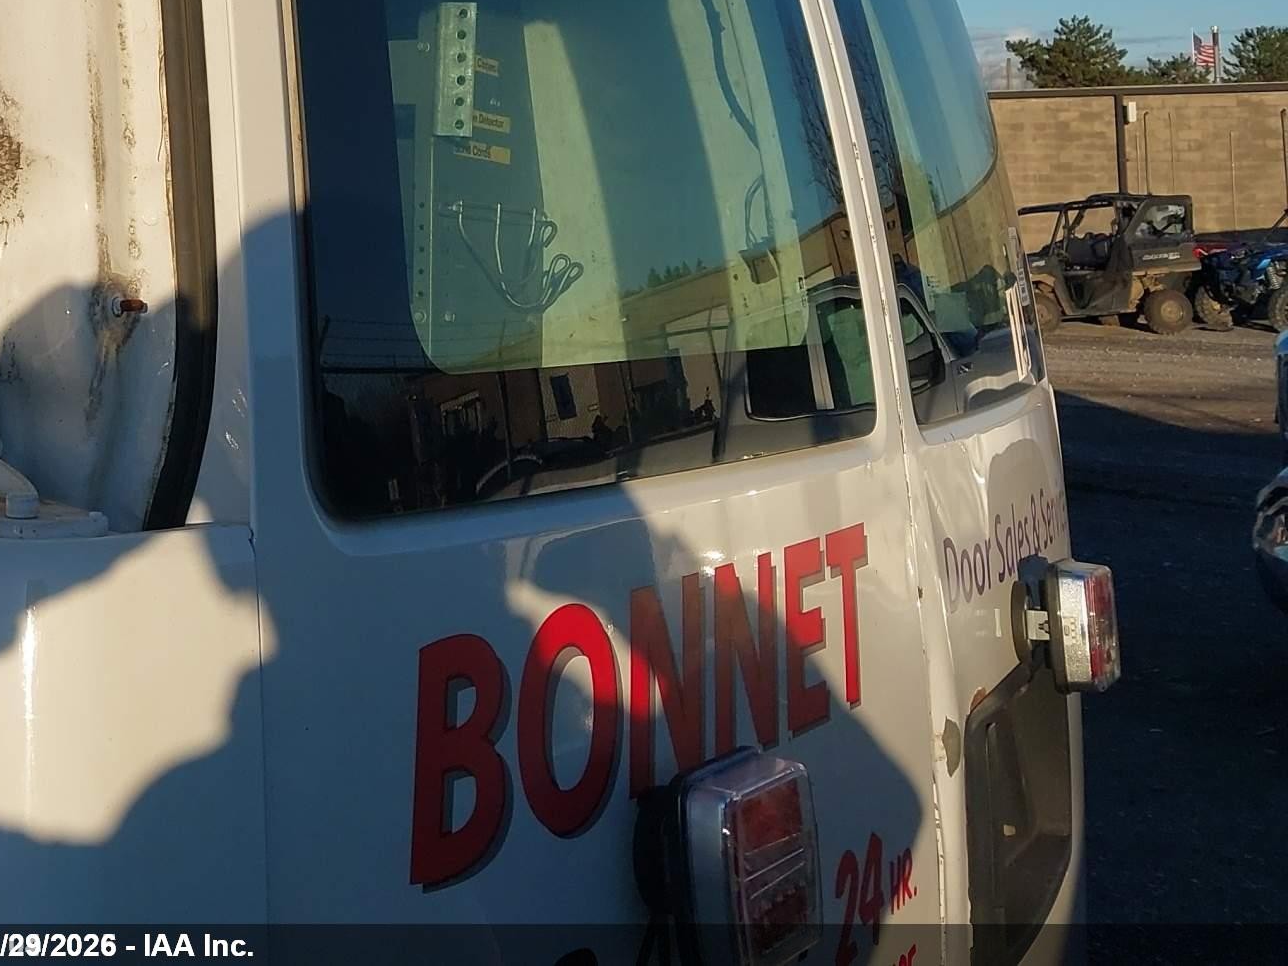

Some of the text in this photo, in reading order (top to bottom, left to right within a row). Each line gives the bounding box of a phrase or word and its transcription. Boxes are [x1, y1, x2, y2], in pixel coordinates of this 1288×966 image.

[942, 536, 992, 614] Door
[994, 502, 1031, 583] Sales
[1030, 493, 1043, 556] &
[409, 522, 868, 893] BONNET
[834, 830, 919, 966] 24 HR.
